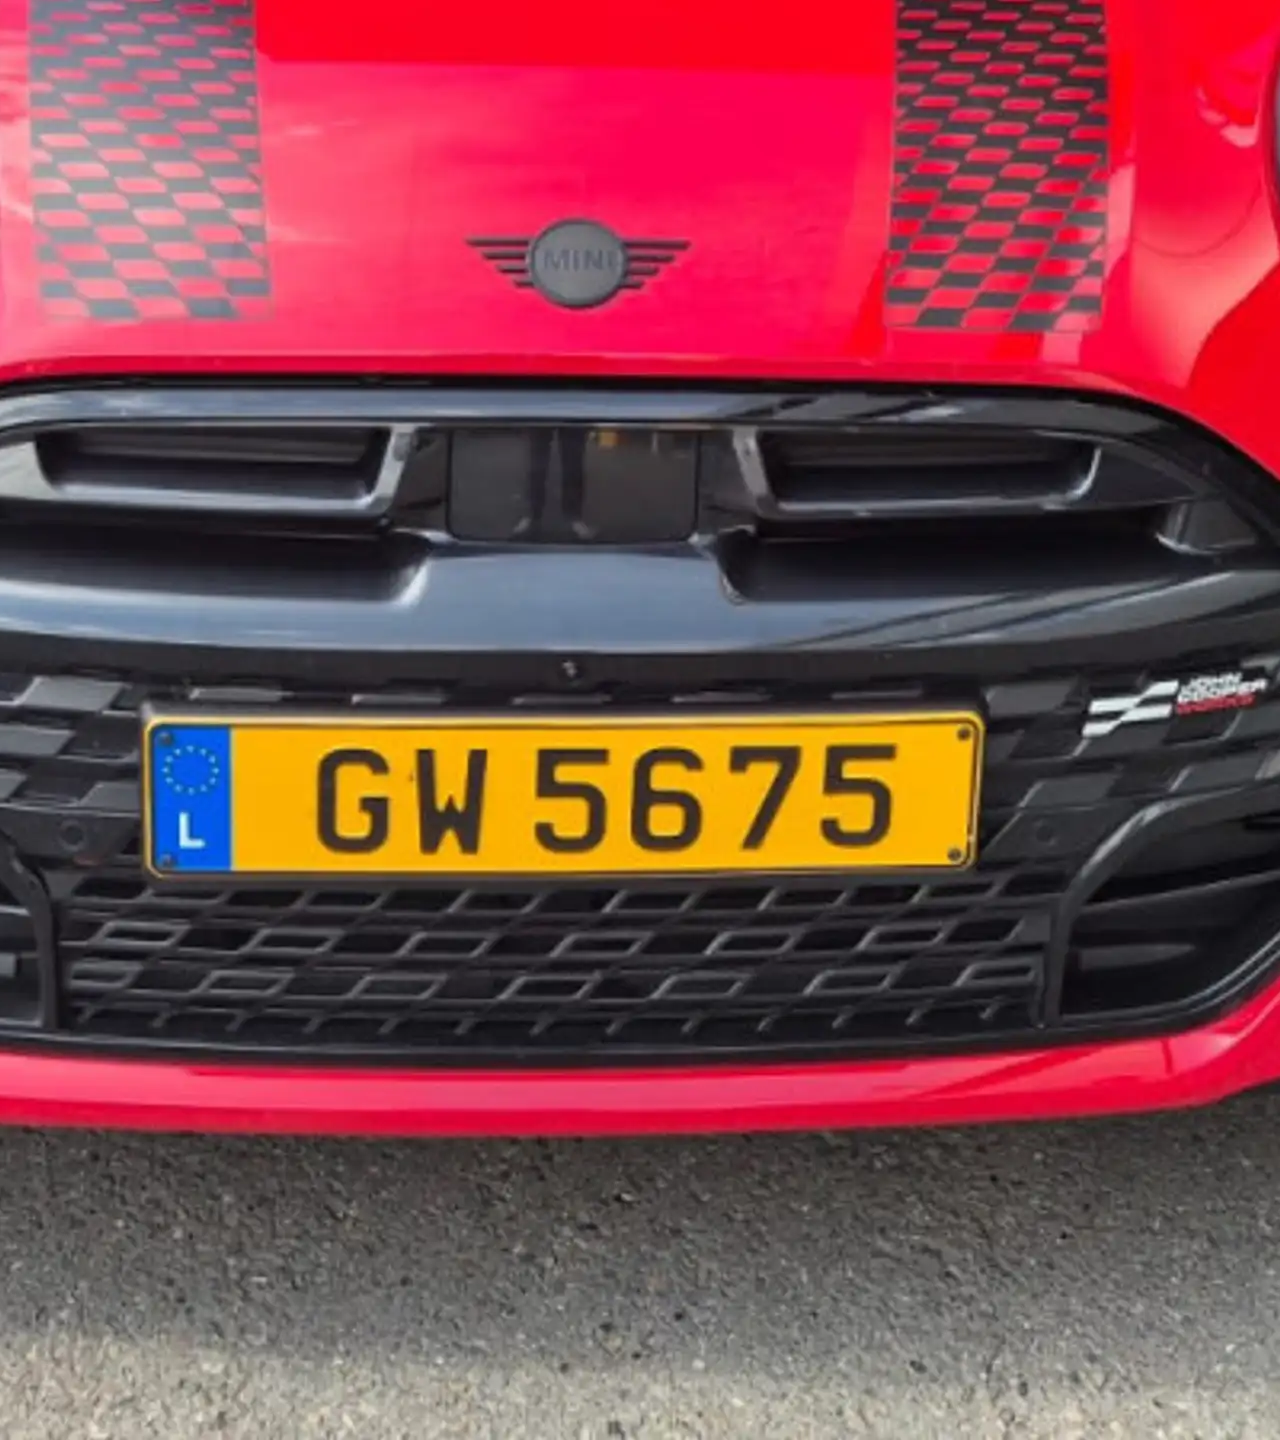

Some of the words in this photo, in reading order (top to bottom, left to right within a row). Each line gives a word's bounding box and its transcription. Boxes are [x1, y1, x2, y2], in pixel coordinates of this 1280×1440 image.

[543, 248, 619, 272] MINI
[317, 747, 488, 855] GW
[534, 744, 898, 853] 5675
[179, 811, 205, 850] L
